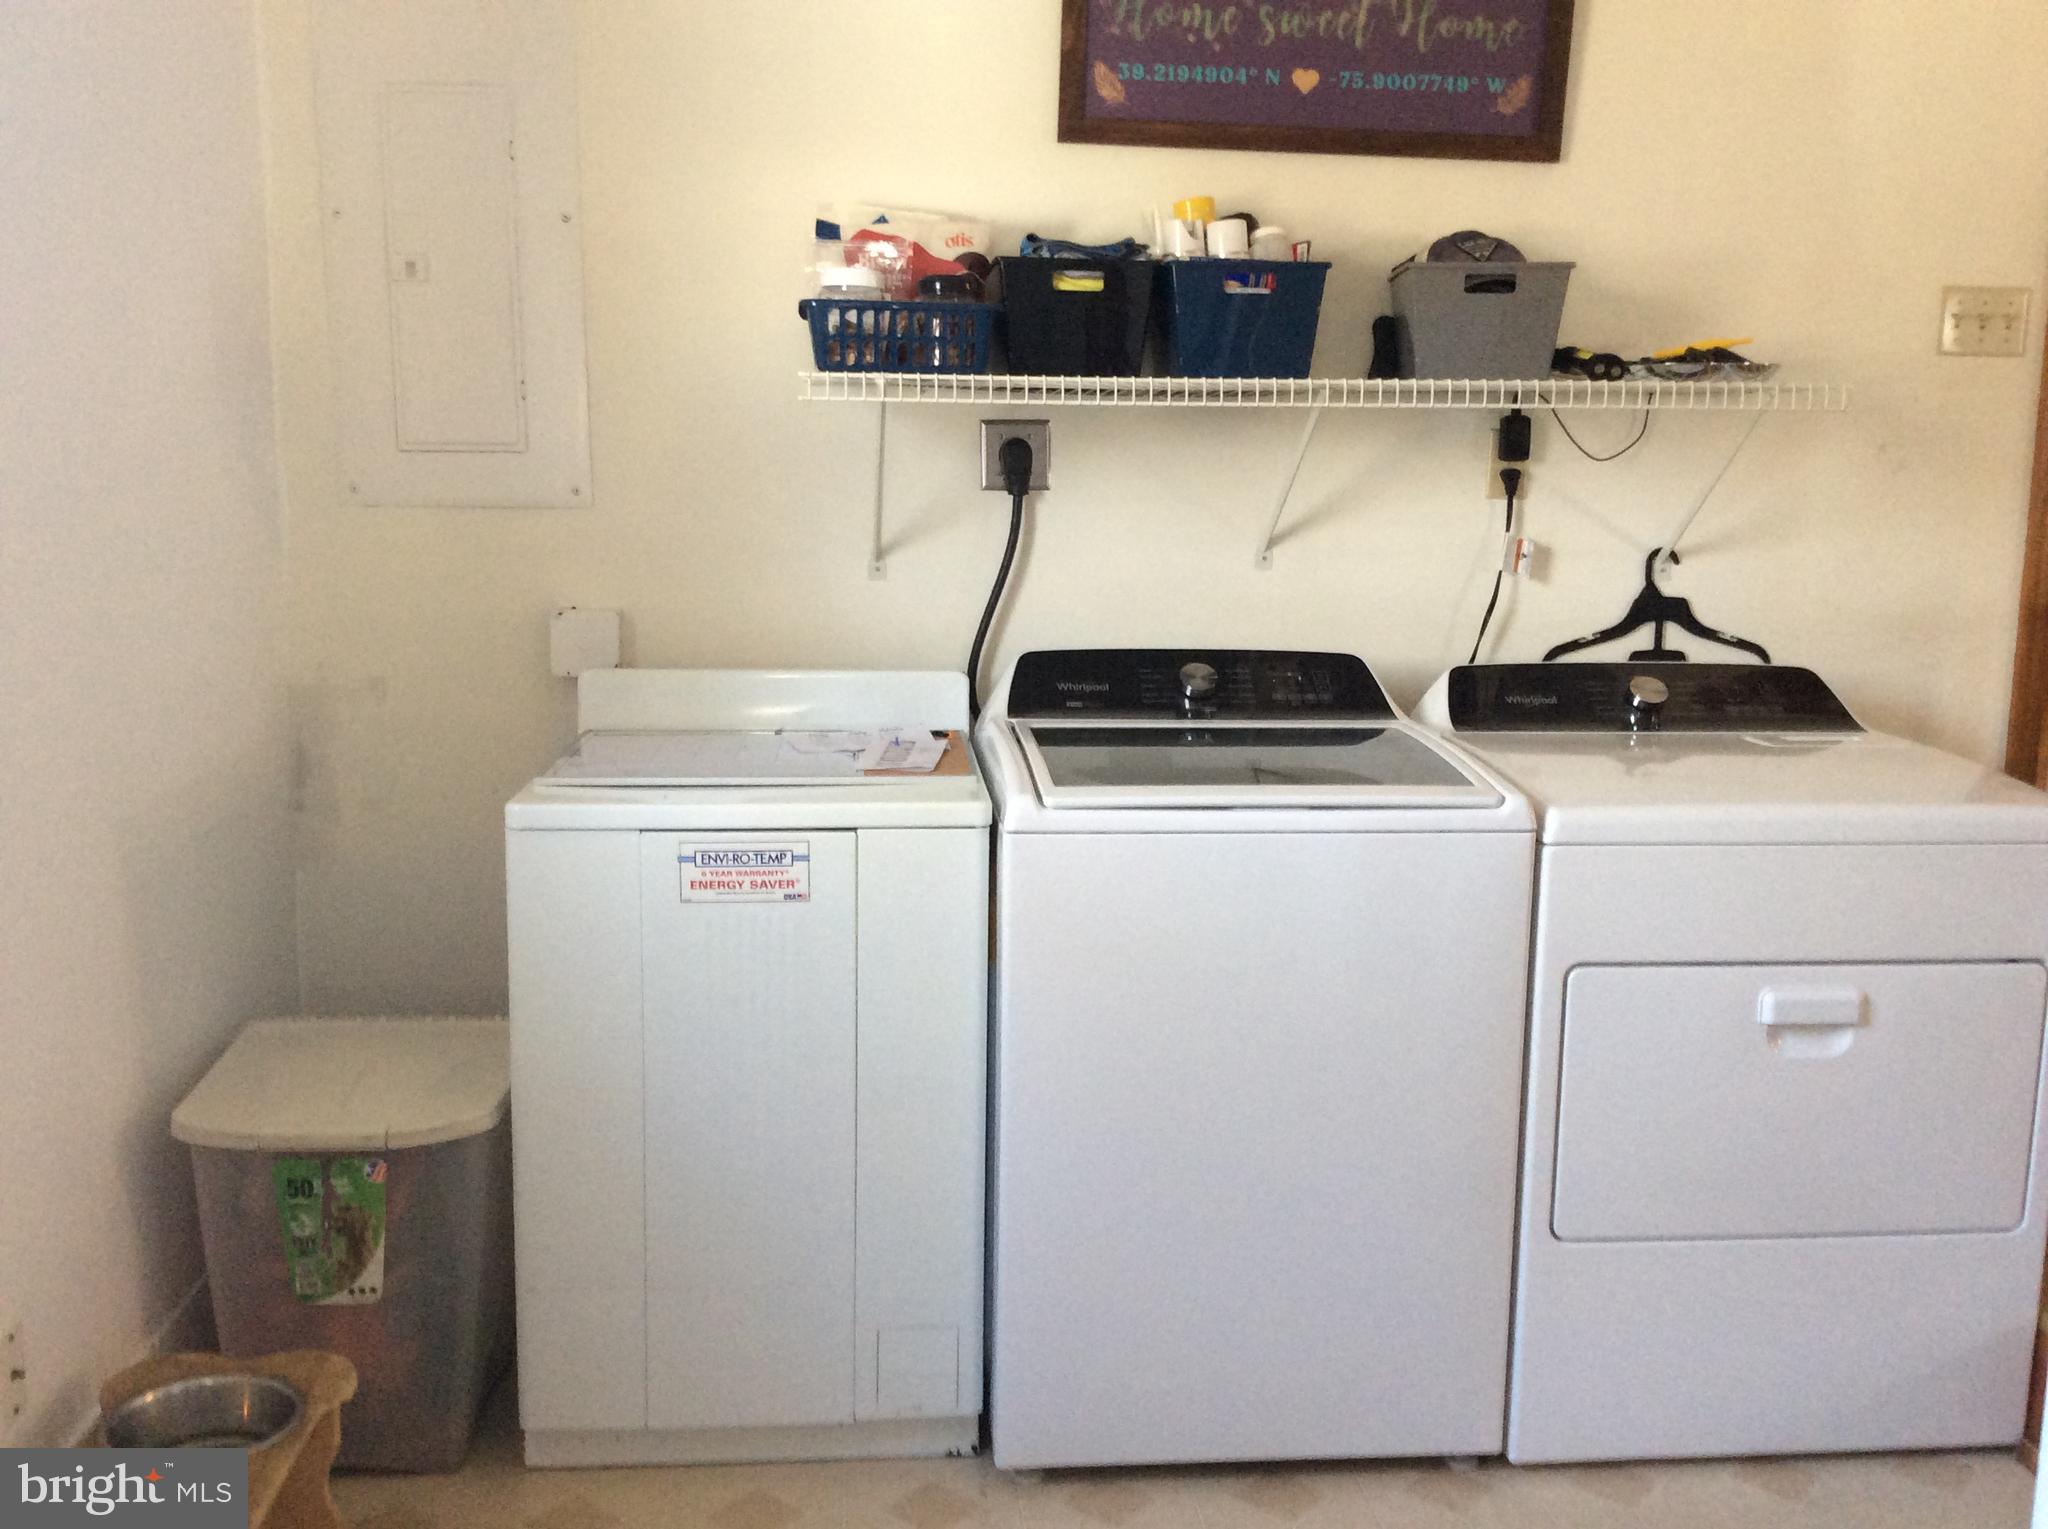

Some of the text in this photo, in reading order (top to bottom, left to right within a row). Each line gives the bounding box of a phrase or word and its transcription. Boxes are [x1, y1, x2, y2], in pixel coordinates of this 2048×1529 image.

[1265, 67, 1281, 86] N
[1487, 75, 1505, 93] W
[1056, 682, 1109, 693] Whirlpool
[1505, 695, 1558, 705] Whirlpool
[701, 853, 787, 865] ENVI-RO-TEMP
[690, 880, 745, 890] ENERGY
[286, 1177, 314, 1199] 50
